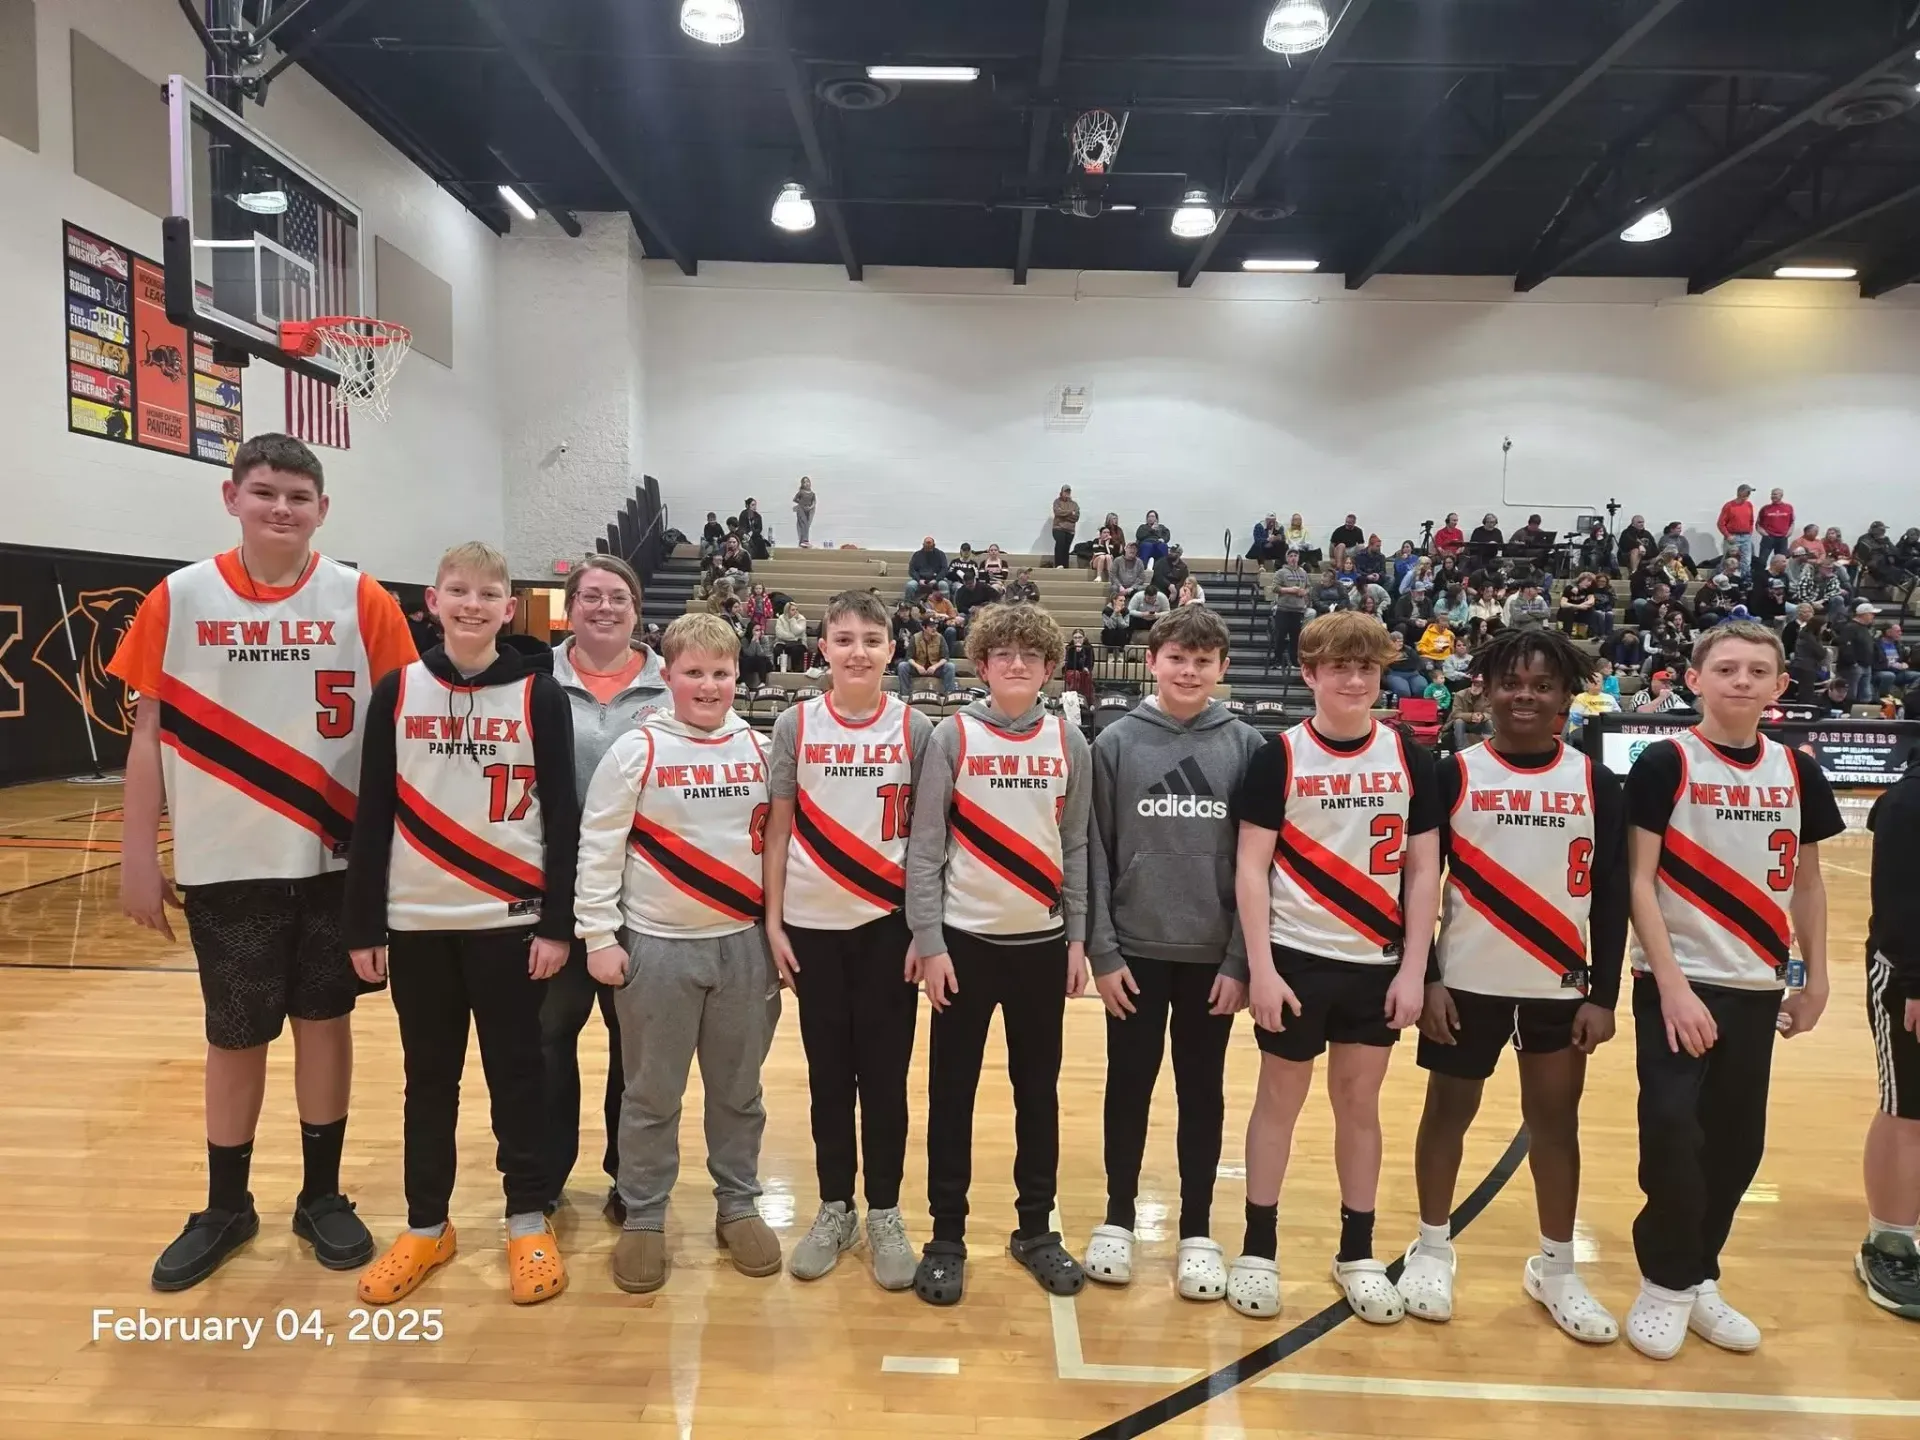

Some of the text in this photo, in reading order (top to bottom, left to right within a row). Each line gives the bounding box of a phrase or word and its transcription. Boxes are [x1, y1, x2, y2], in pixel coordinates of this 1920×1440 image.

[68, 243, 102, 268] MUSKIES
[69, 278, 101, 301] RAIDERS
[145, 287, 166, 304] LEAG
[72, 379, 108, 400] GENERALS
[147, 418, 182, 439] PANTHERS
[196, 621, 336, 645] NEW LEX
[228, 649, 310, 661] PANTHERS
[315, 670, 355, 739] 5
[1116, 698, 1127, 706] LEX
[1271, 702, 1283, 711] LEX
[404, 716, 522, 743] NEW LEX
[1621, 725, 1650, 734] NEW
[1808, 732, 1897, 744] PANTHERS
[429, 742, 497, 756] PANTHERS
[804, 743, 903, 764] NEW LEX
[656, 762, 764, 788] NEW LEX
[824, 766, 884, 777] PANTHERS
[966, 755, 1064, 778] NEW LEX
[483, 763, 536, 823] 17
[683, 785, 750, 799] PANTHERS
[990, 778, 1048, 789] PANTHERS
[1294, 772, 1403, 797] NEW LEX
[1320, 796, 1384, 810] PANTHERS
[1470, 789, 1586, 816] NEW LEX
[1689, 782, 1795, 808] NEW LEX
[1137, 794, 1227, 819] adidas
[1716, 808, 1781, 822] PANTHERS
[1496, 813, 1566, 828] PANTHERS
[1567, 836, 1593, 897] 8
[1767, 828, 1798, 891] 3
